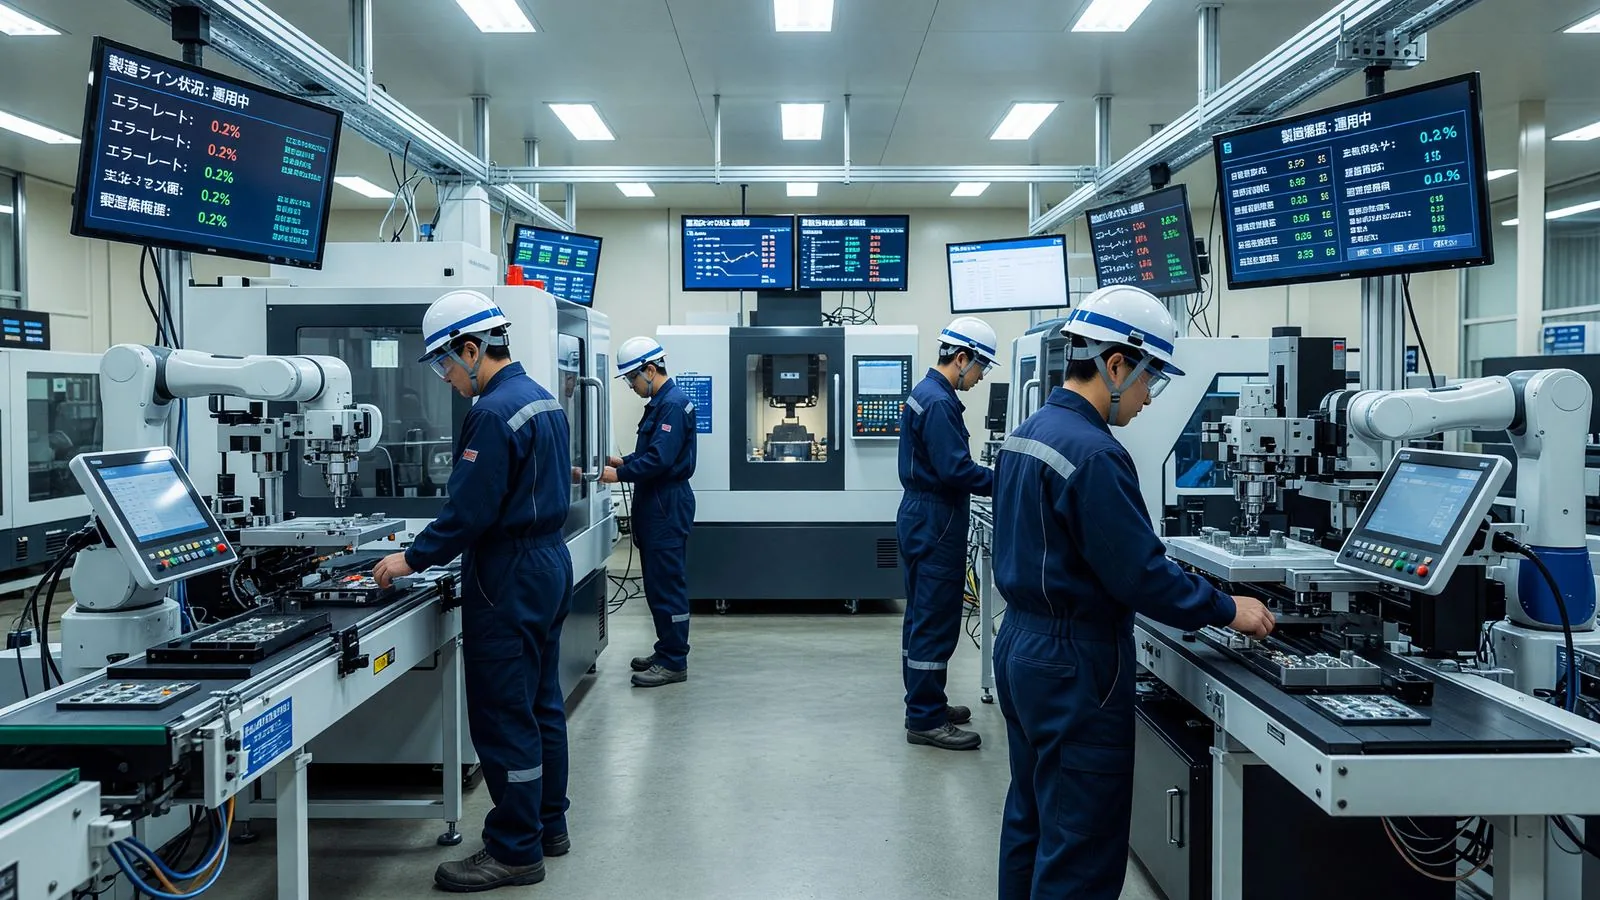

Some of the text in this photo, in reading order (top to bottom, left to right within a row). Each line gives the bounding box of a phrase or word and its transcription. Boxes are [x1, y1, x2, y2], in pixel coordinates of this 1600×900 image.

[112, 93, 194, 126] エラーレート:
[109, 119, 191, 149] エラーレート:
[211, 120, 241, 139] 0.2%
[1420, 125, 1457, 143] 0.2%
[106, 144, 188, 173] エラーレート:
[208, 143, 237, 161] 0.2%
[204, 166, 234, 184] 0.2%
[201, 189, 230, 206] 0.2%
[198, 211, 228, 228] 0.2%
